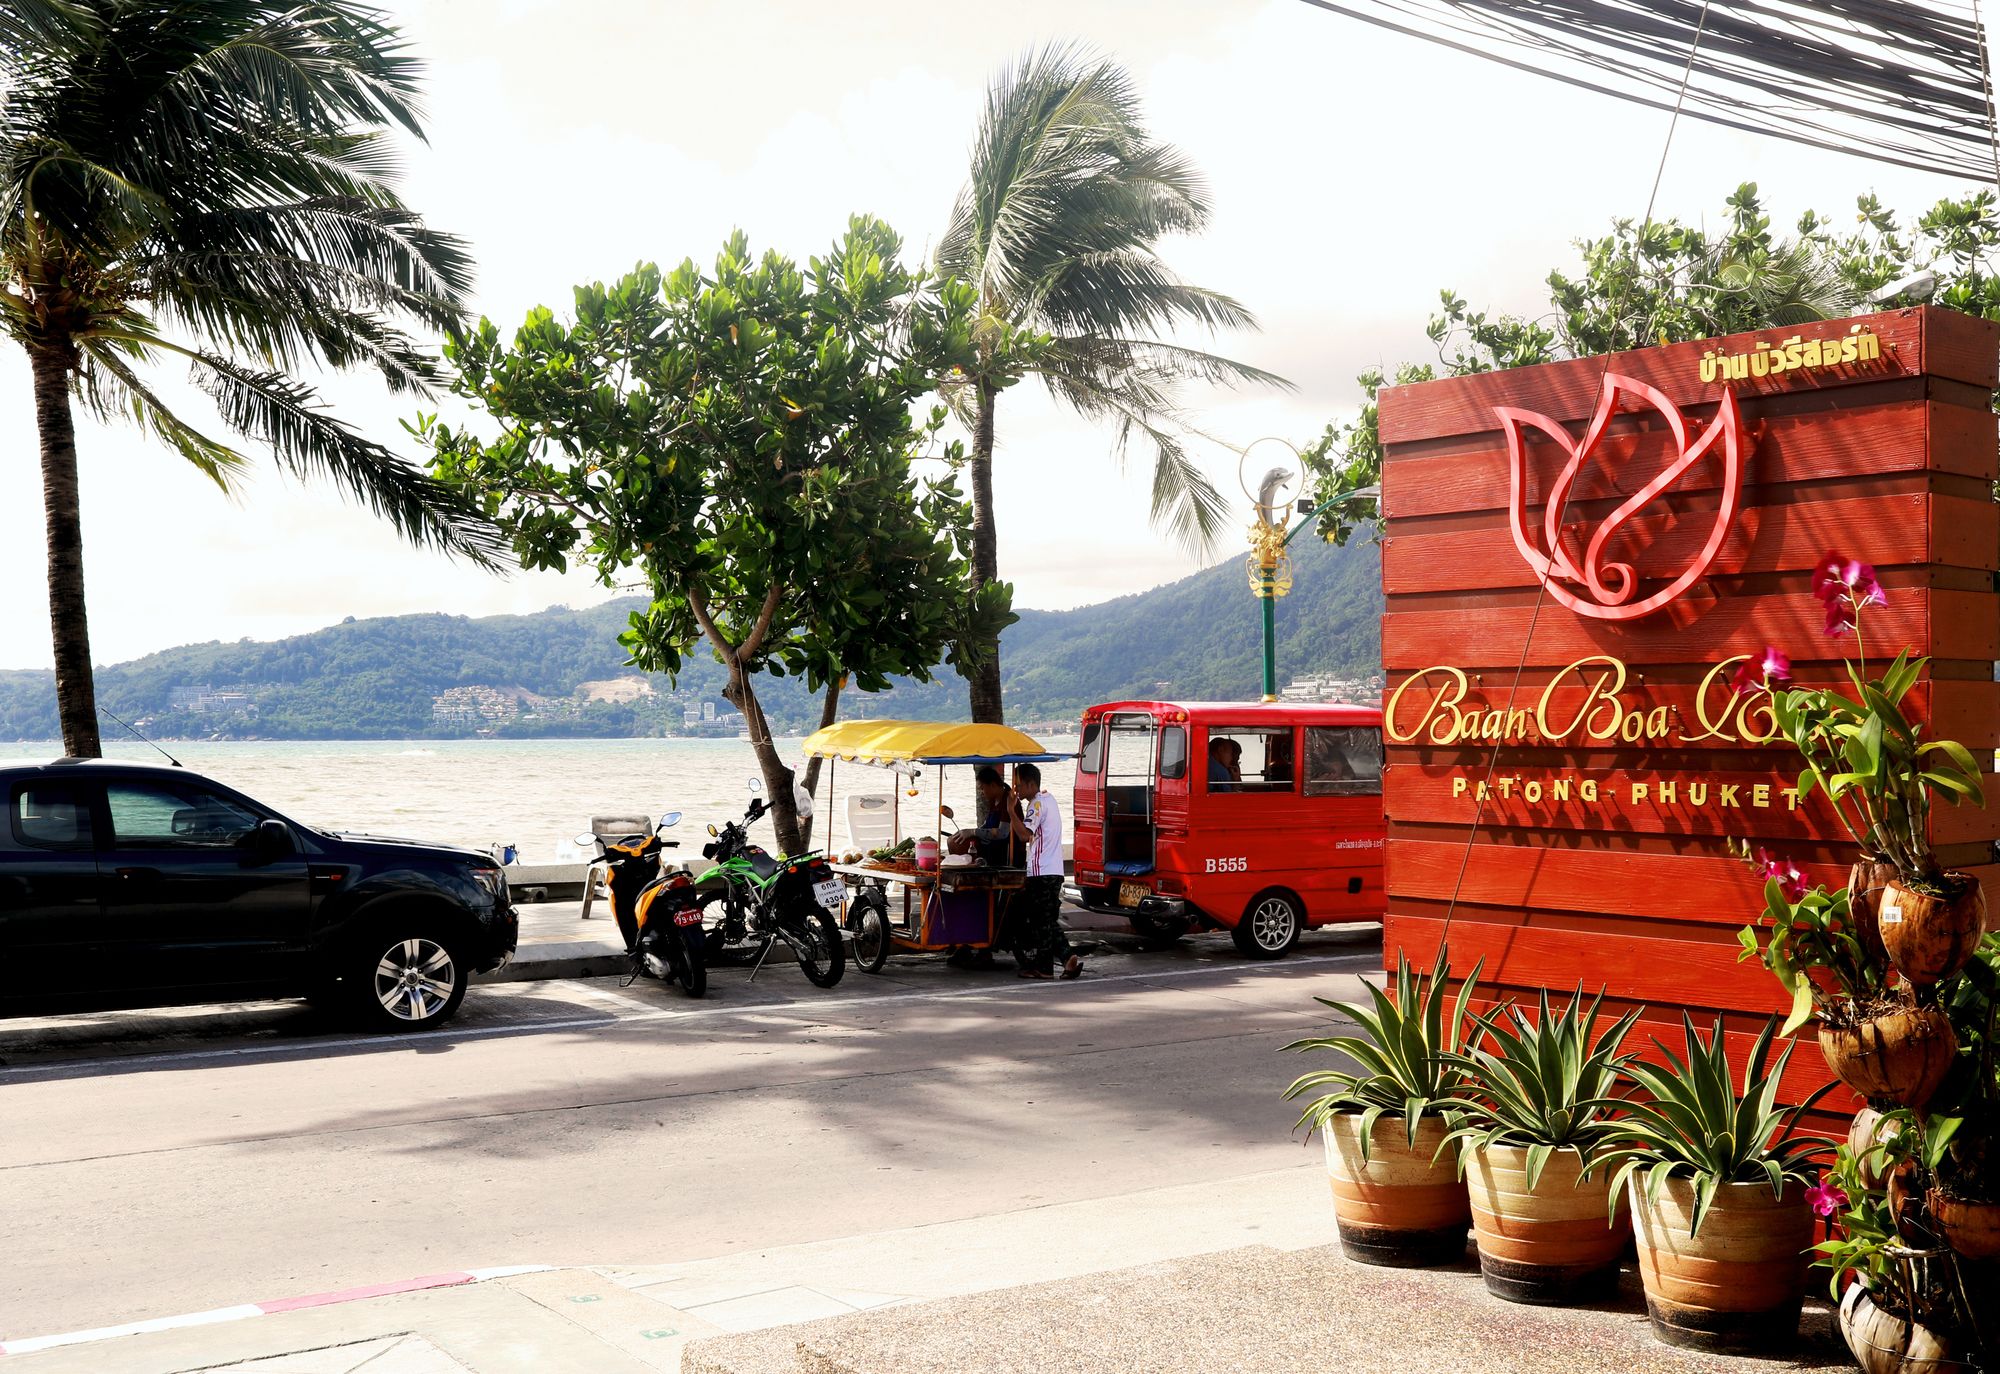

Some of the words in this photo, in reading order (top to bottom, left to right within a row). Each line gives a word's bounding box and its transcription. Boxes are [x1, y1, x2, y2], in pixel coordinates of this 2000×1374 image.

[1385, 665, 1527, 745] Baan
[1537, 655, 1670, 742] Boa
[1452, 777, 1598, 803] PATONG
[1632, 781, 1800, 811] PHUKET
[825, 894, 844, 904] 4304
